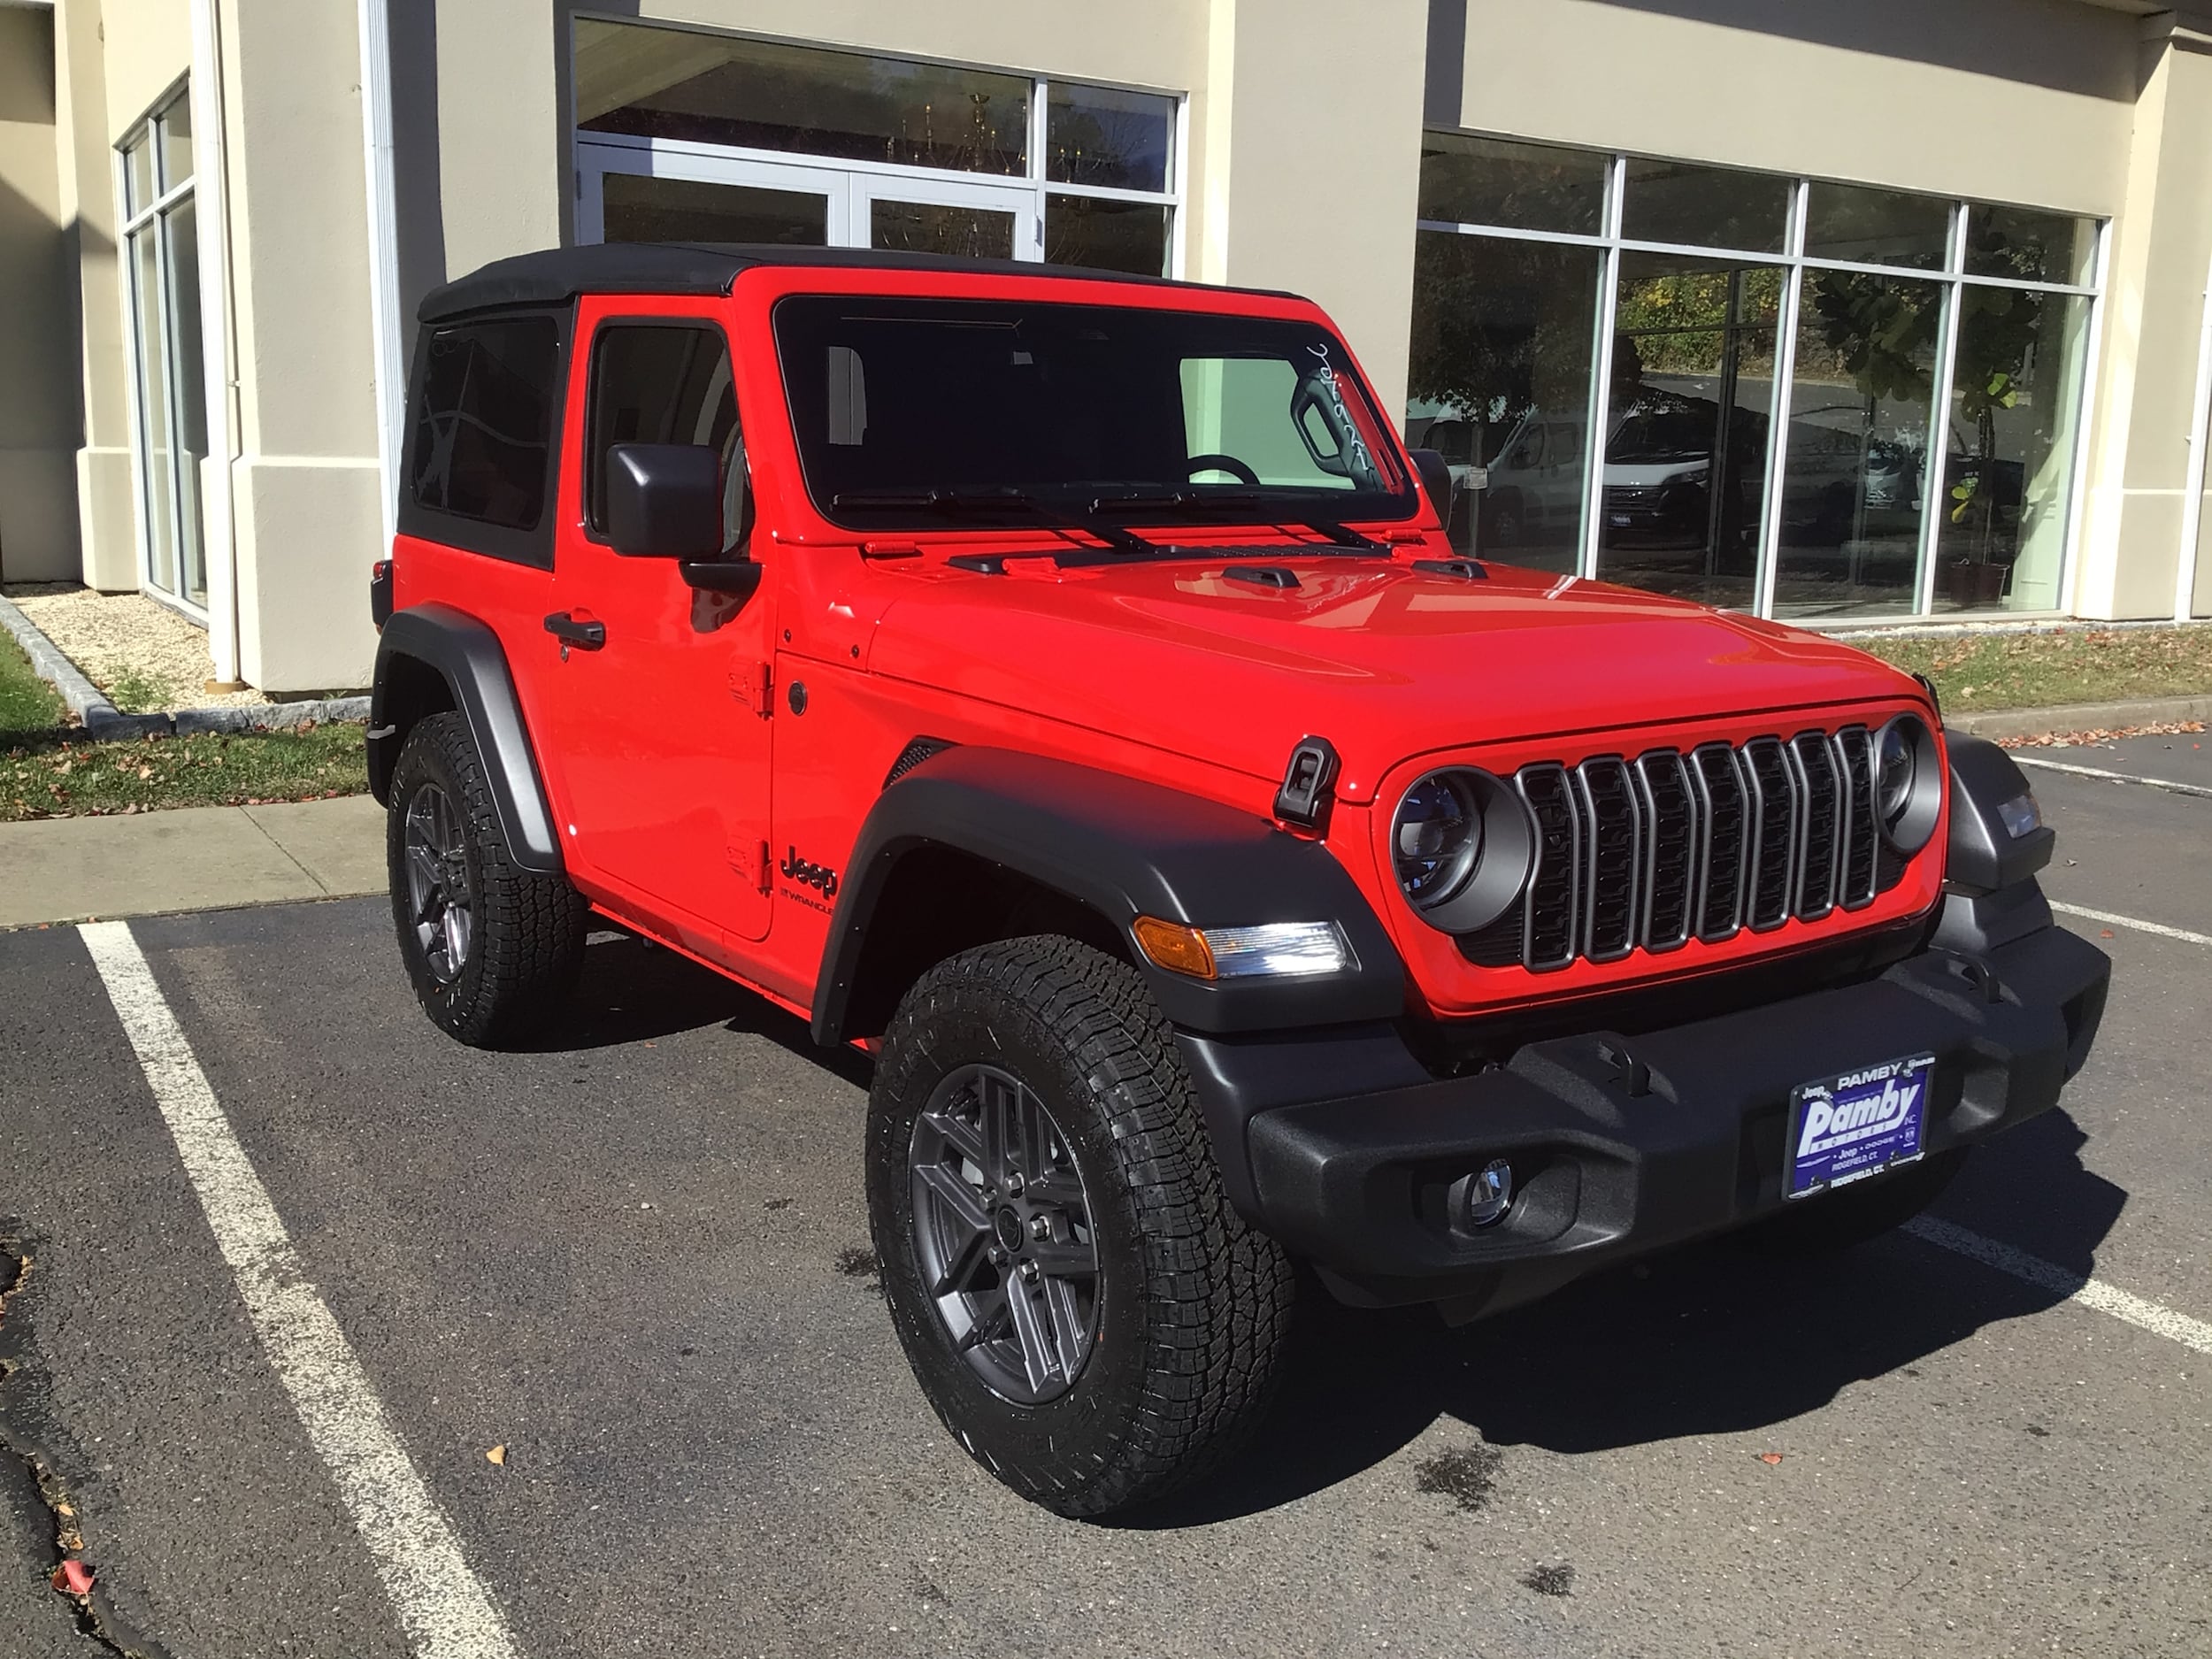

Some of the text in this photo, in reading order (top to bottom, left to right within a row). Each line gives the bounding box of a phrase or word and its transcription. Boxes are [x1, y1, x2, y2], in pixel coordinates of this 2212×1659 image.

[780, 845, 838, 901] Jeep
[788, 891, 834, 916] WRANGLE
[1838, 1062, 1903, 1091] PAMBY
[1801, 1087, 1824, 1100] Jeep
[1797, 1079, 1921, 1158] Pamby
[1816, 1124, 1887, 1150] MOTORS
[1838, 1146, 1858, 1160] Jeep
